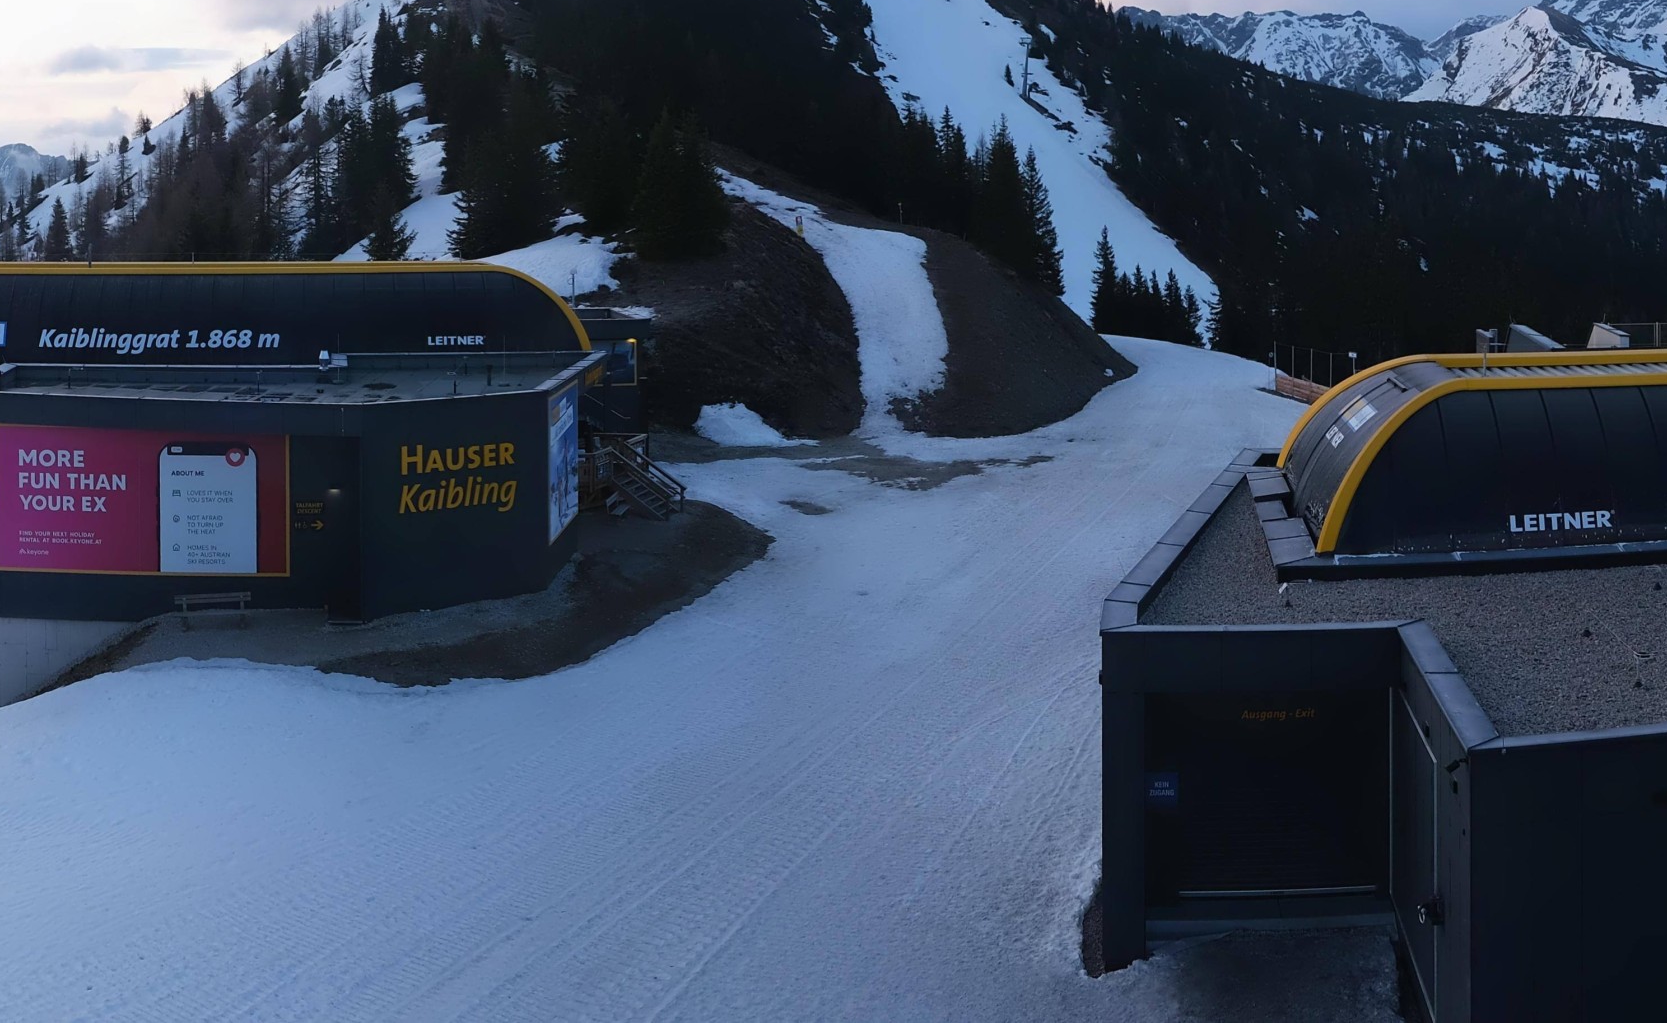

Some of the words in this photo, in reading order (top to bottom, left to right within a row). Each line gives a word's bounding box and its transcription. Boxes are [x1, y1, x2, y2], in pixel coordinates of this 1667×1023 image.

[38, 328, 180, 354] Kaiblinggrat
[185, 330, 252, 348] 1.868
[258, 333, 280, 348] m
[427, 335, 484, 345] LEITNER
[18, 449, 84, 467] MORE
[401, 442, 516, 476] HAUSER
[18, 472, 60, 489] FUN
[67, 473, 126, 491] THAN
[19, 495, 75, 511] YOUR
[82, 496, 107, 512] EX
[398, 476, 518, 514] Kaibling
[1509, 510, 1612, 532] LEITNER
[27, 548, 49, 556] keyone
[1241, 710, 1287, 721] Ausgang
[1296, 707, 1315, 718] Exit
